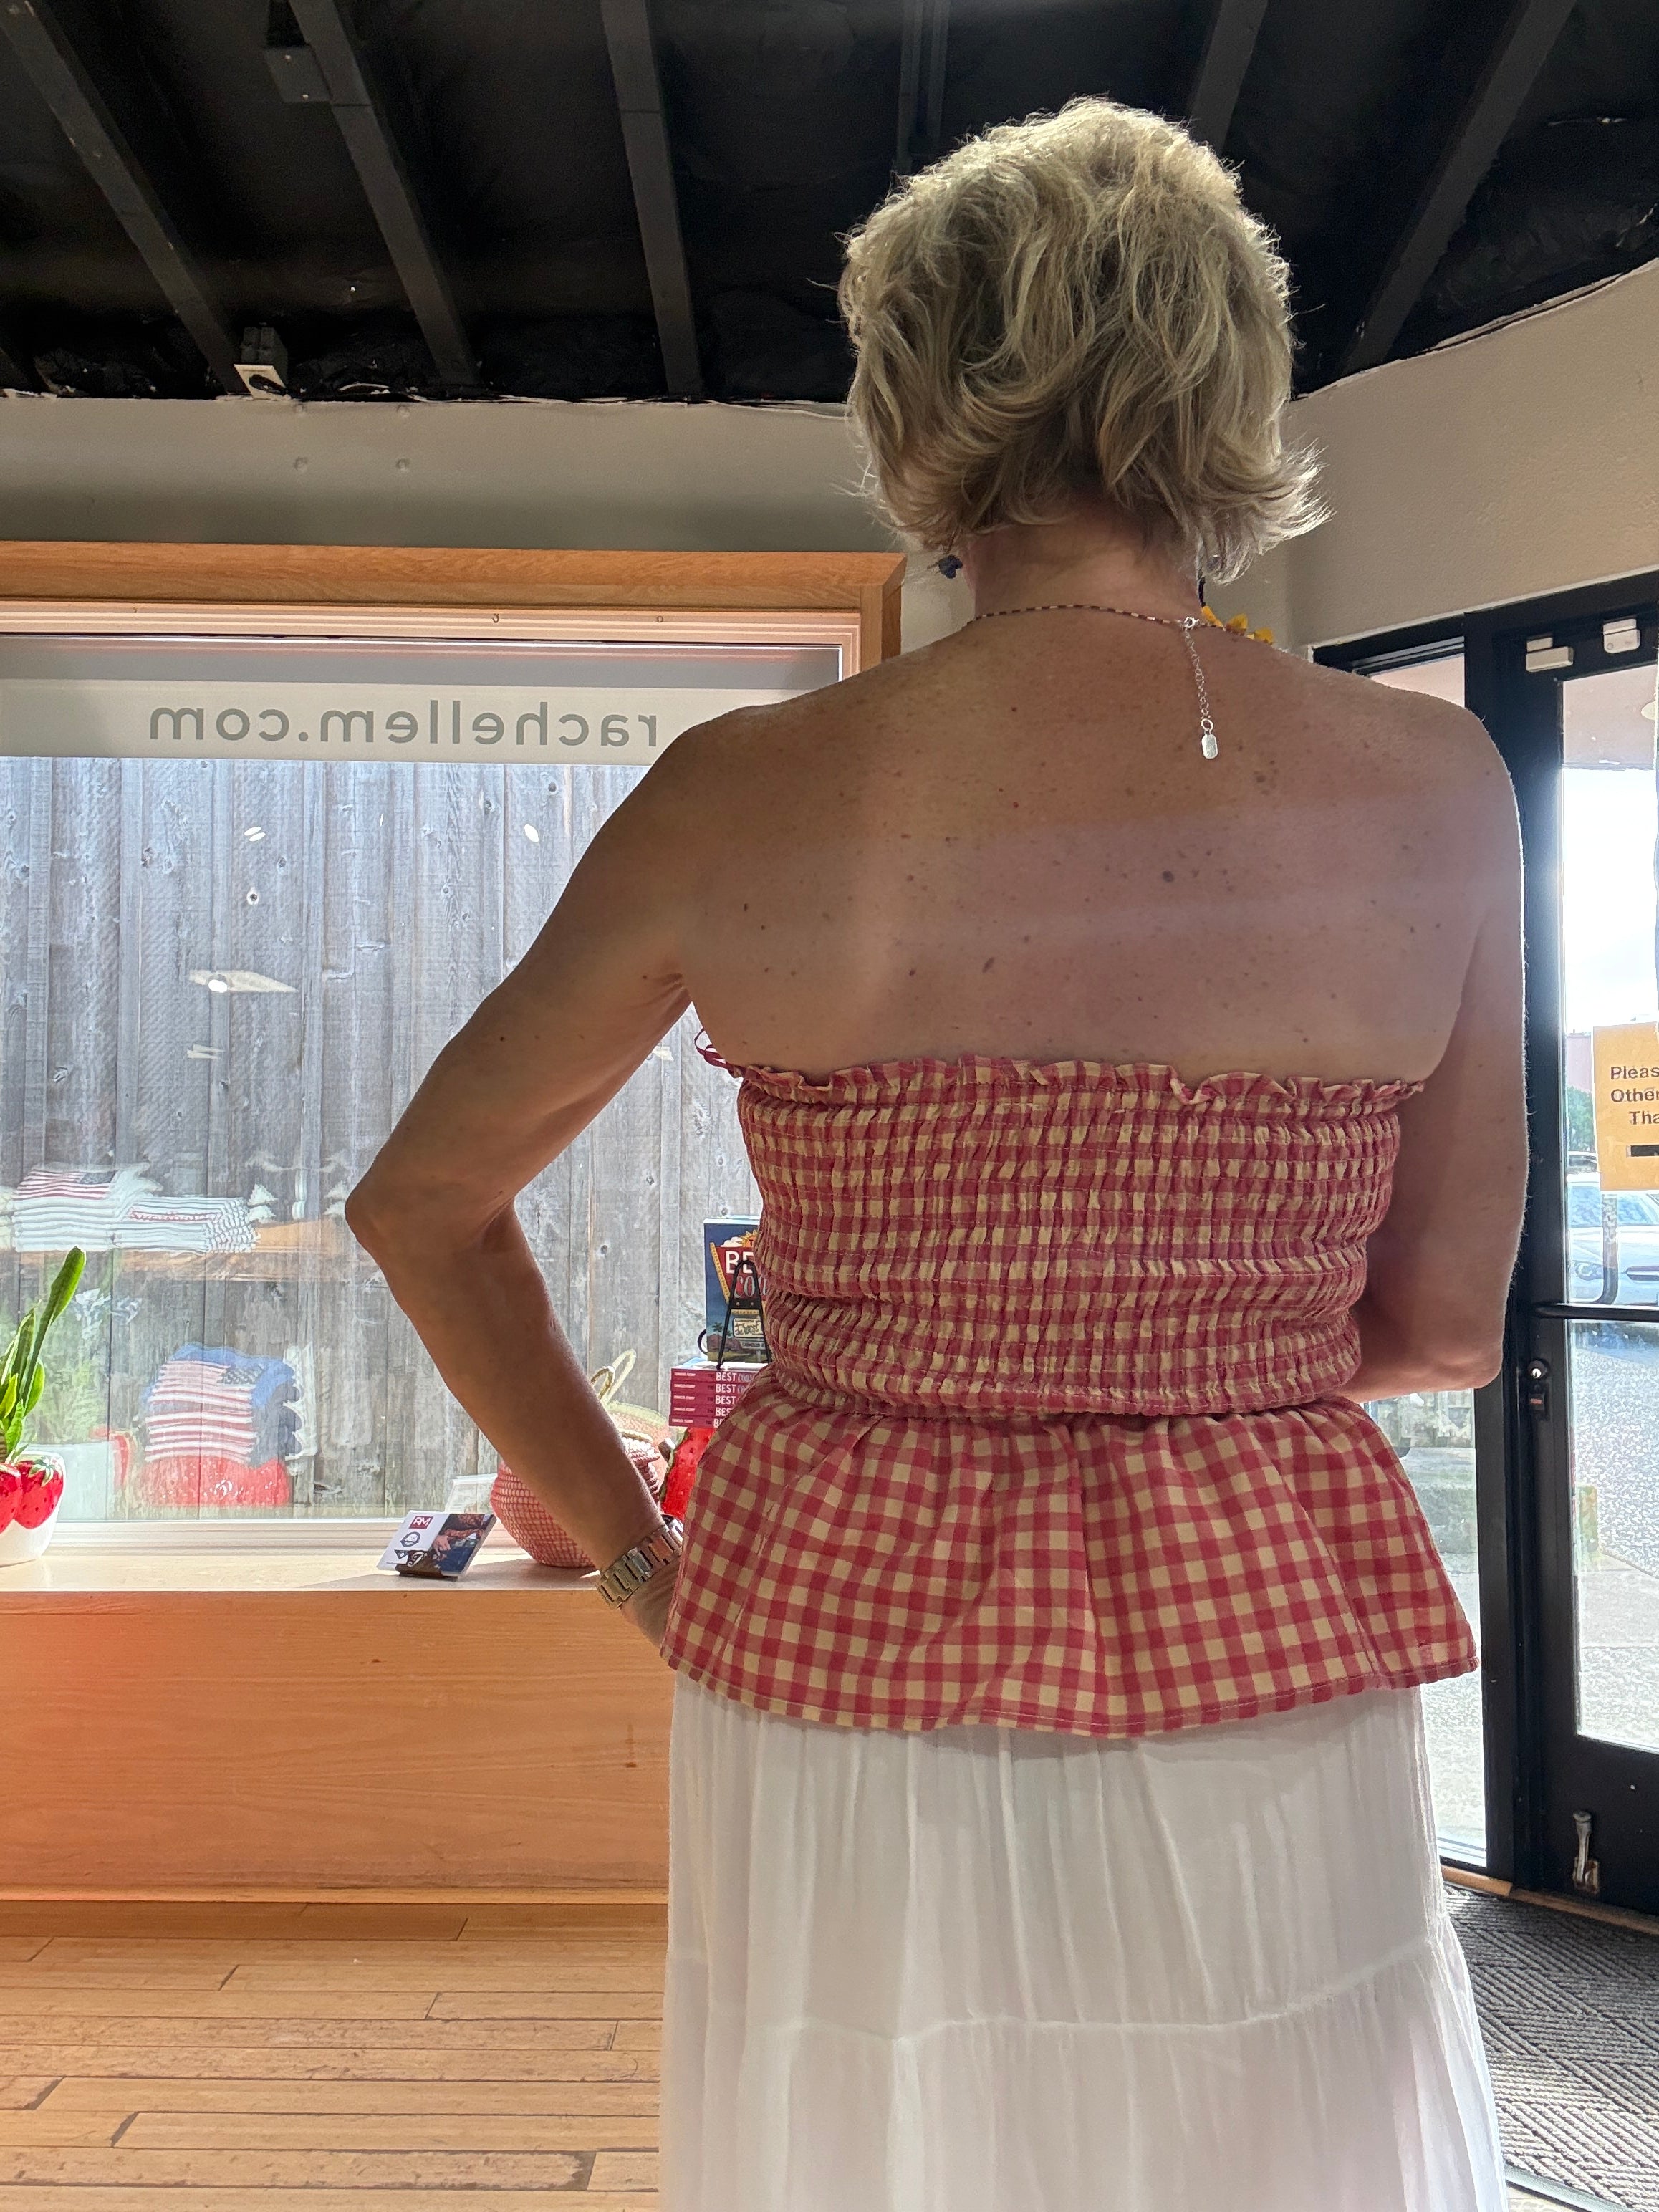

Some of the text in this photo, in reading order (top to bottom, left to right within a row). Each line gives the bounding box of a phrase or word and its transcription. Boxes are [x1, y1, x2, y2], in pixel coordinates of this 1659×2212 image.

[725, 1250, 754, 1274] BE
[716, 1372, 737, 1381] BEST
[716, 1383, 736, 1393] BEST
[715, 1395, 736, 1405] BEST
[715, 1407, 731, 1416] BES
